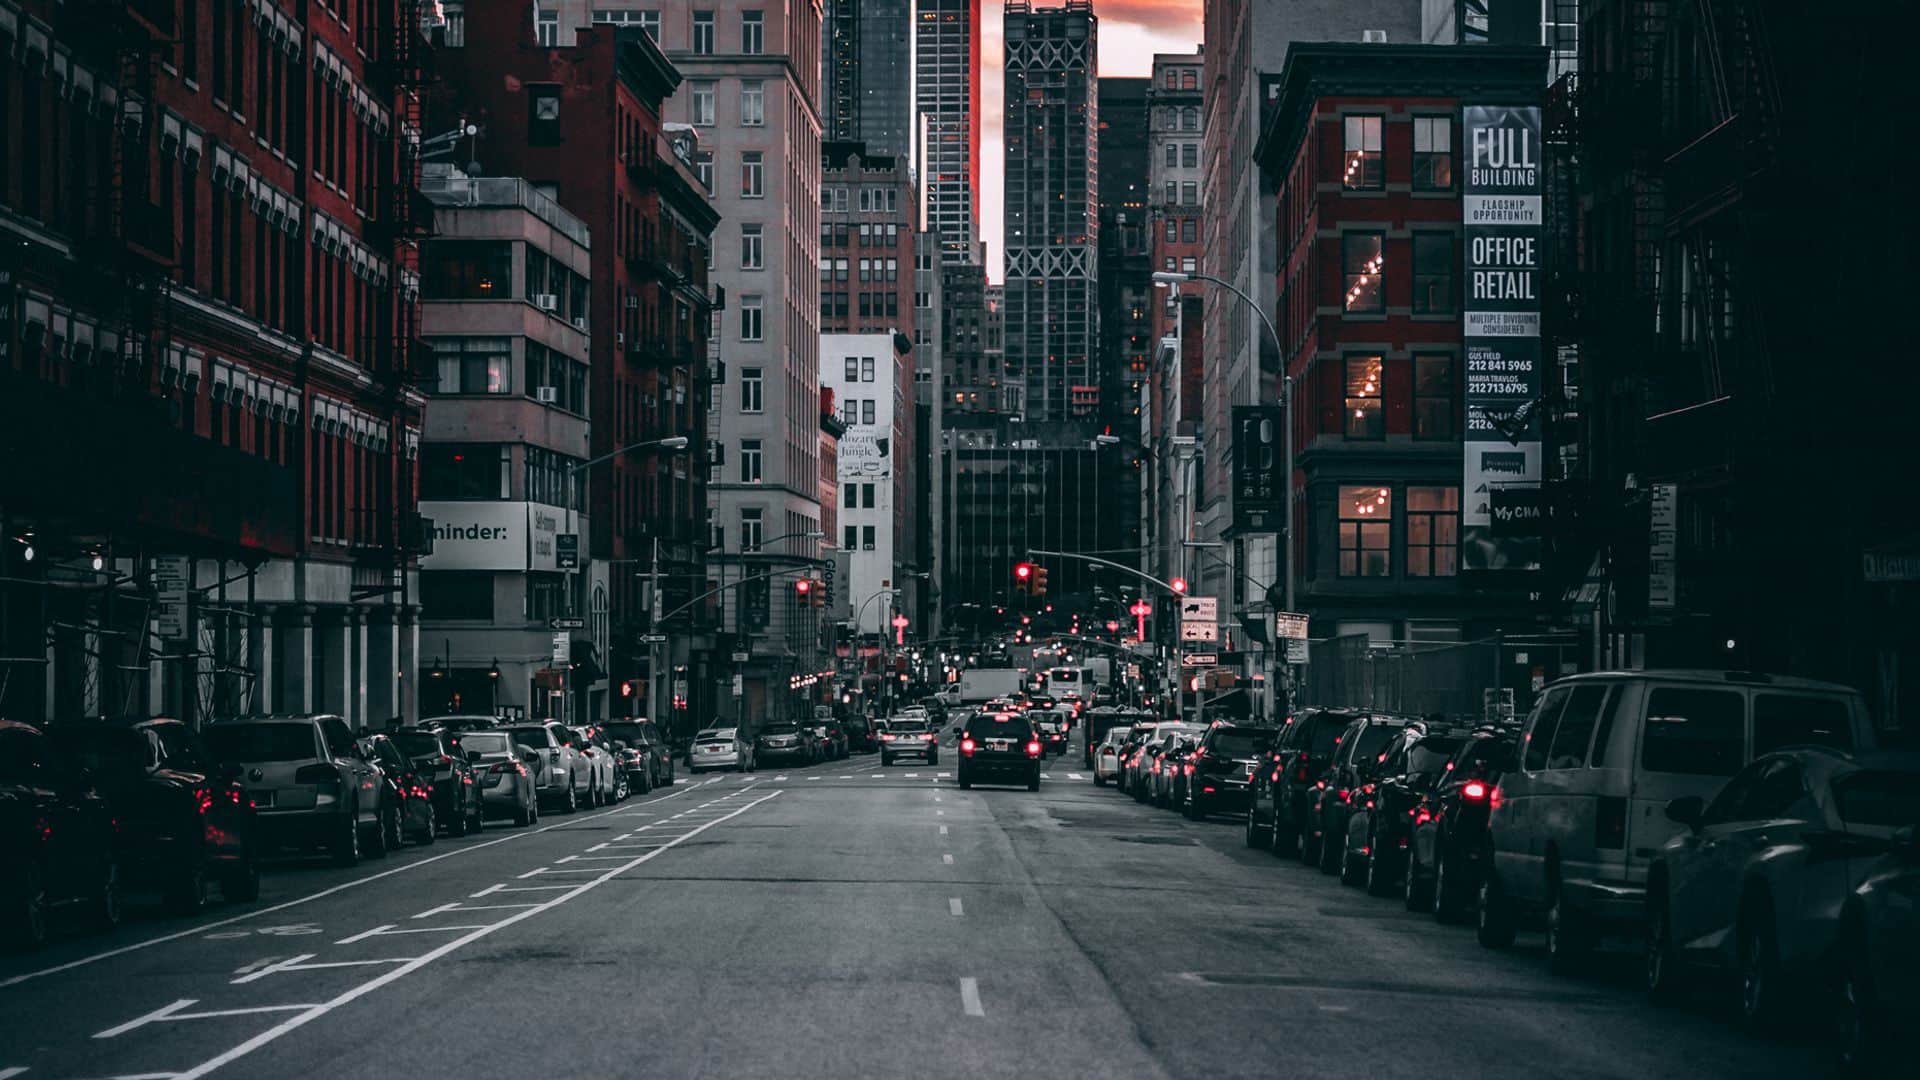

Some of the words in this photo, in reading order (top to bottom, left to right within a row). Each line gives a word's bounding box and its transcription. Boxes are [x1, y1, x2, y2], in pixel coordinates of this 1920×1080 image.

[1473, 128, 1536, 168] FULL
[1472, 169, 1535, 186] BUILDING
[1482, 200, 1525, 210] FLAGSHIP
[1473, 210, 1535, 221] OPPORTUNITY
[1472, 237, 1535, 265] OFFICE
[1474, 271, 1535, 299] RETAIL
[1470, 314, 1501, 324] MULTIPLE
[1482, 324, 1525, 335] CONSIDERED
[1468, 352, 1482, 360] GUS
[1483, 352, 1501, 360] FIELD
[1468, 360, 1487, 371] 212
[1488, 360, 1506, 371] 841
[1507, 360, 1533, 371] 5965
[1468, 383, 1486, 393] 212
[1487, 383, 1505, 393] 713
[1505, 383, 1529, 394] 6795
[1468, 420, 1486, 430] 212
[841, 447, 873, 458] Jungle
[824, 558, 836, 610] Glossier
